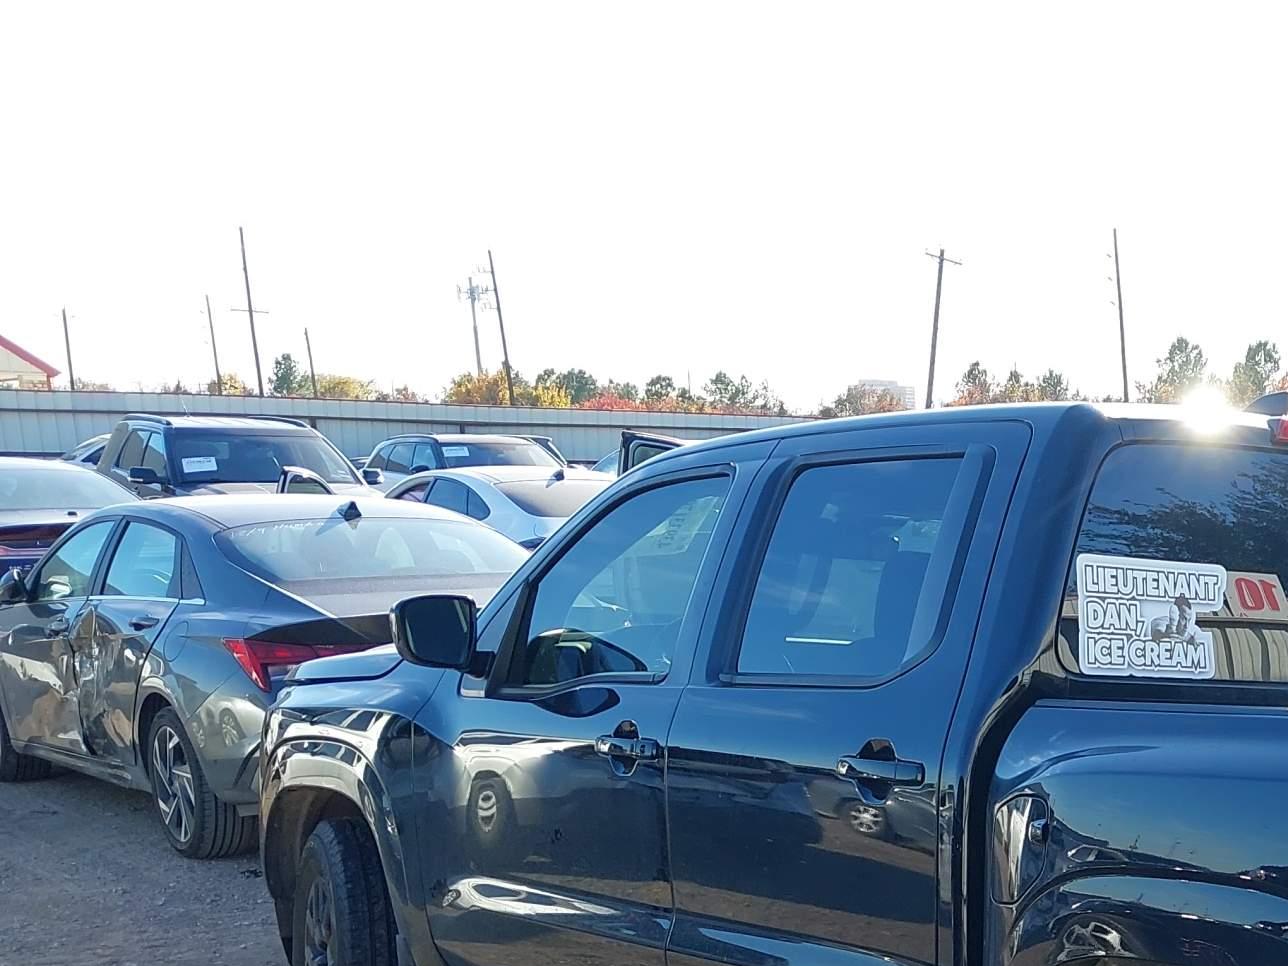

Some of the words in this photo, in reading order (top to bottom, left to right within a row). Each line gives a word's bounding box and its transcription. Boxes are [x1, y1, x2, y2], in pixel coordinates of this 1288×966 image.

[1084, 565, 1219, 601] LIEUTENANT
[1087, 600, 1144, 637] DAN,
[1087, 637, 1125, 666] ICE
[1128, 640, 1206, 671] CREAM
